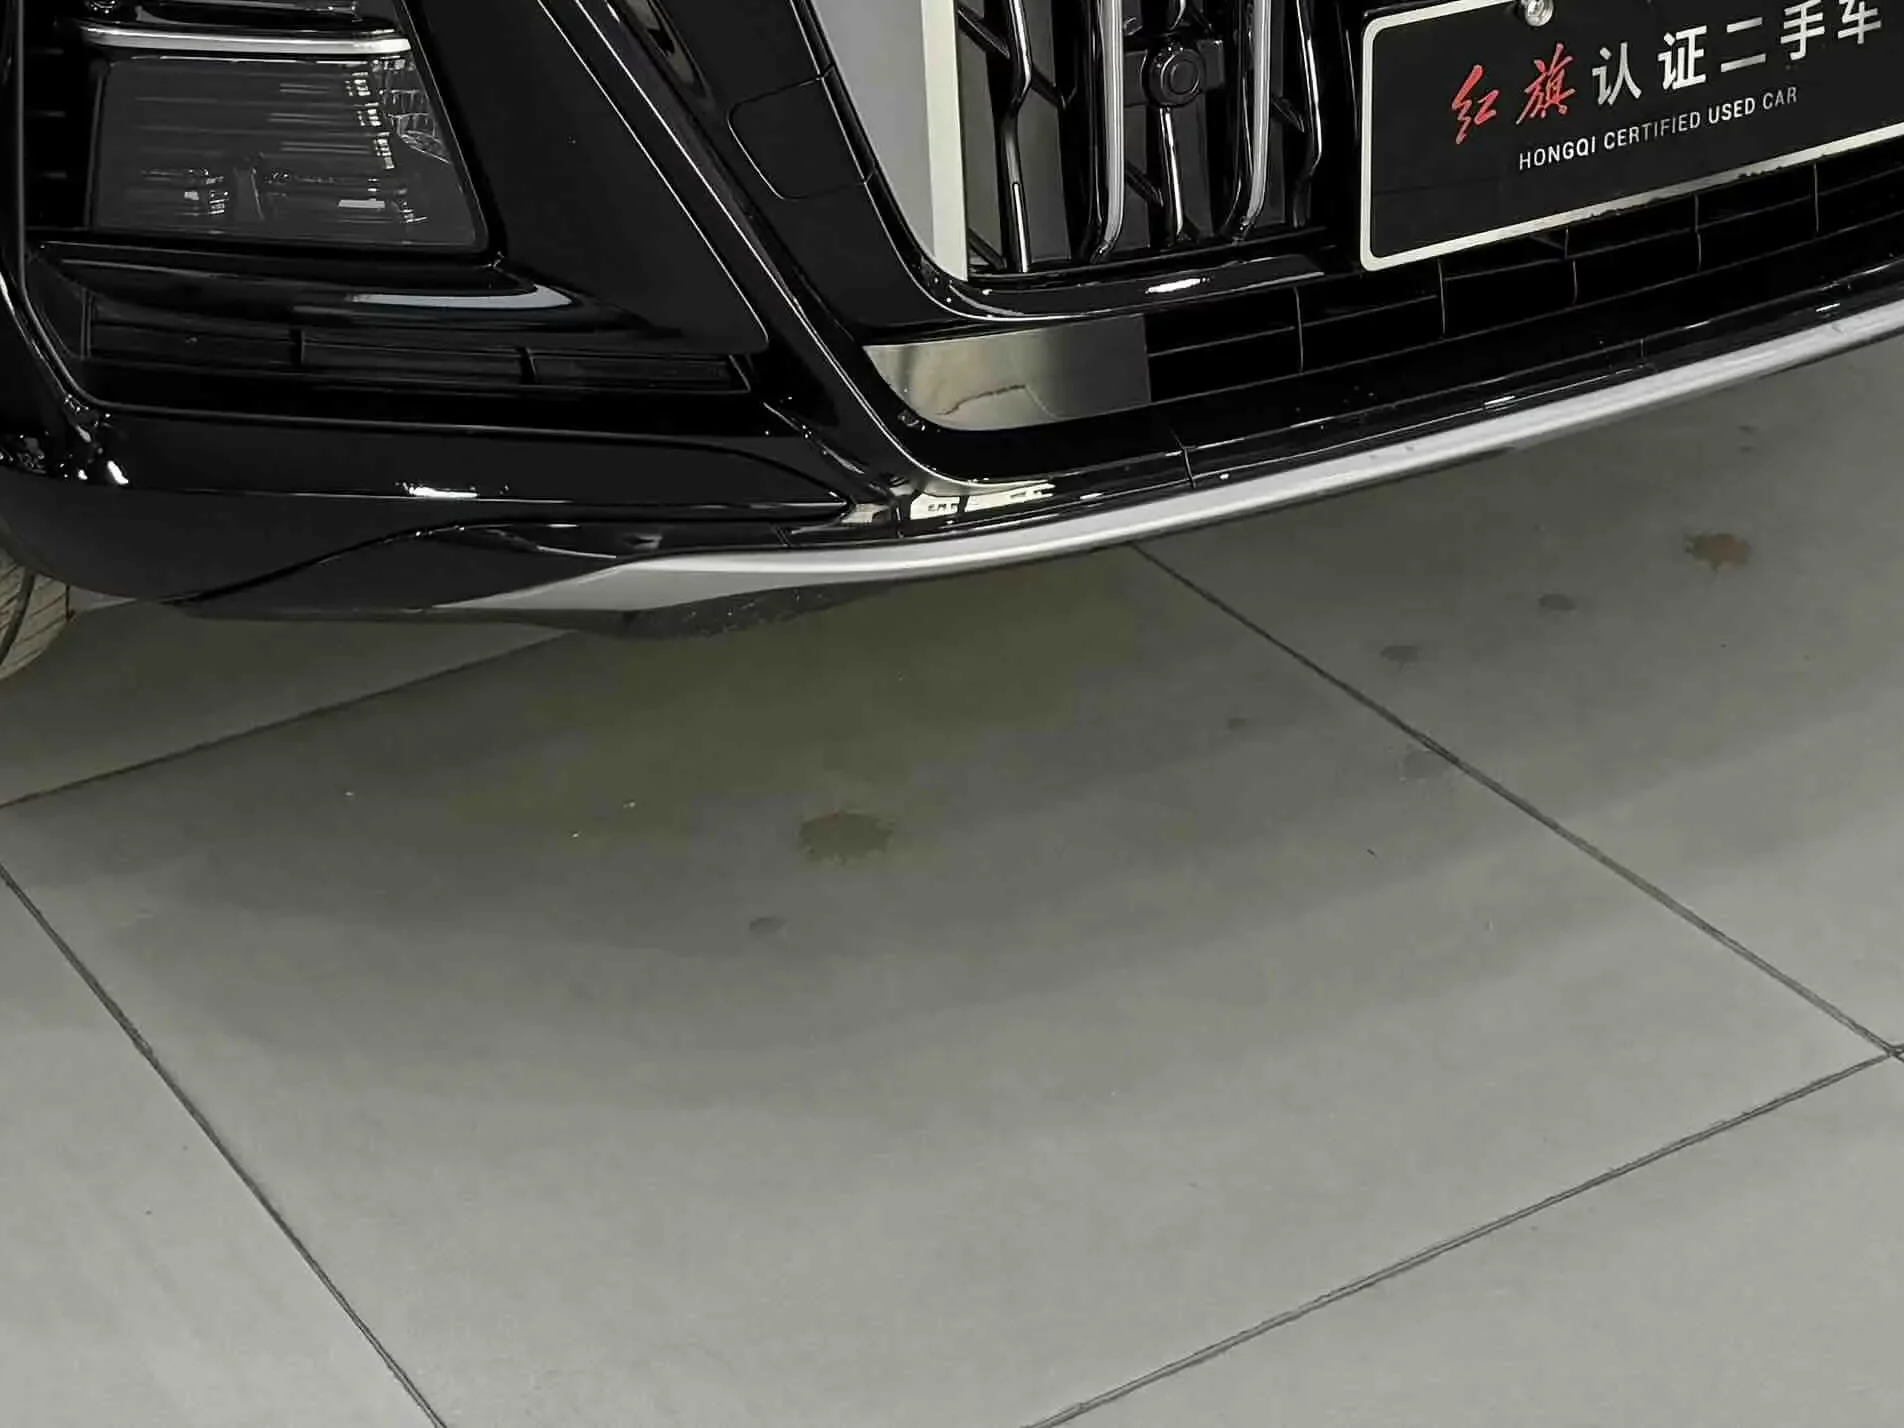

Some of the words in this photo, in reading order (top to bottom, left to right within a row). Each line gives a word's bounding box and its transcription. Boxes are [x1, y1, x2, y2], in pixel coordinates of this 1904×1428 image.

[1518, 133, 1598, 171] HONGQI
[1603, 111, 1701, 151] CERTIFIED
[1707, 97, 1756, 126] USED
[1762, 86, 1798, 112] CAR
